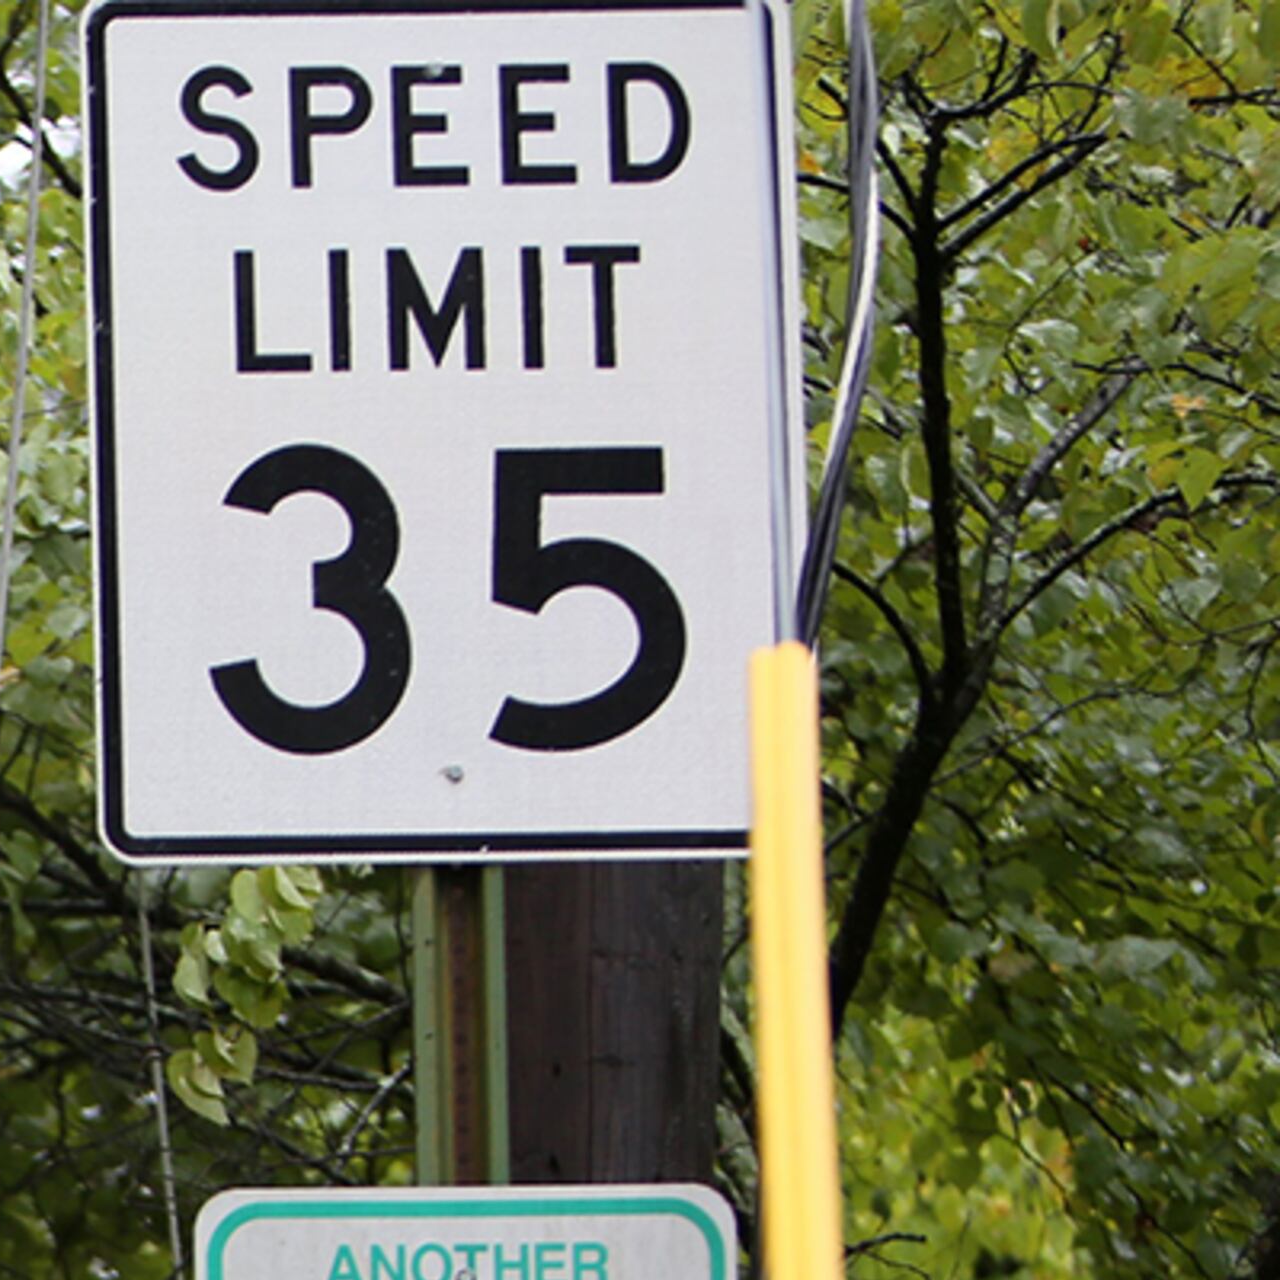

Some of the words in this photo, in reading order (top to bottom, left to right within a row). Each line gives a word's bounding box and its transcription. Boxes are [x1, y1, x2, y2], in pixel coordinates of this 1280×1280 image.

[177, 62, 691, 192] SPEED
[233, 246, 641, 374] LIMIT
[208, 444, 687, 756] 35
